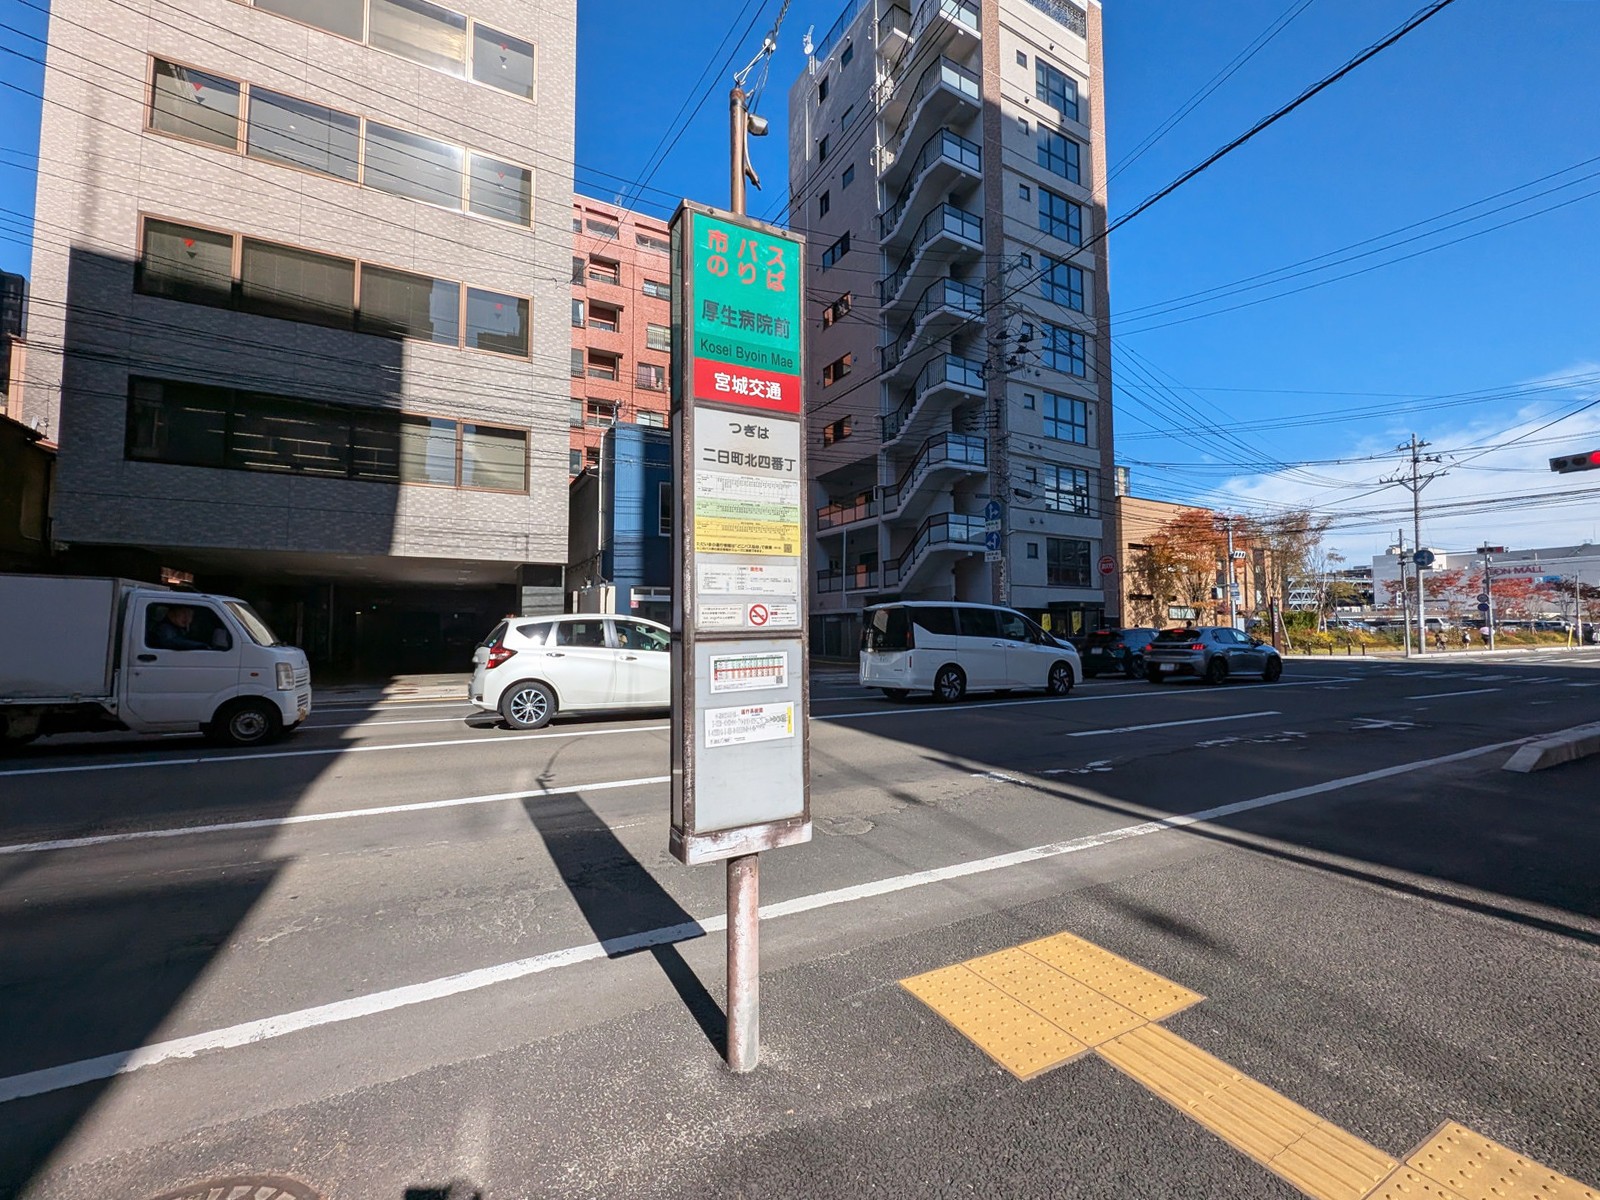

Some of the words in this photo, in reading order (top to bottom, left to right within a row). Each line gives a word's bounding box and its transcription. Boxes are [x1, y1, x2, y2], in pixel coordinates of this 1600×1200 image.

[707, 229, 786, 270] 市バス
[706, 254, 785, 292] のりば
[701, 299, 790, 339] 厚生病院前
[701, 338, 732, 356] Kosei
[736, 346, 768, 364] Byoin
[771, 354, 793, 368] Mae
[714, 372, 782, 400] 宮城交通
[729, 422, 770, 440] つぎは
[703, 447, 797, 472] 二日町北四番丁
[1514, 565, 1545, 574] MALL
